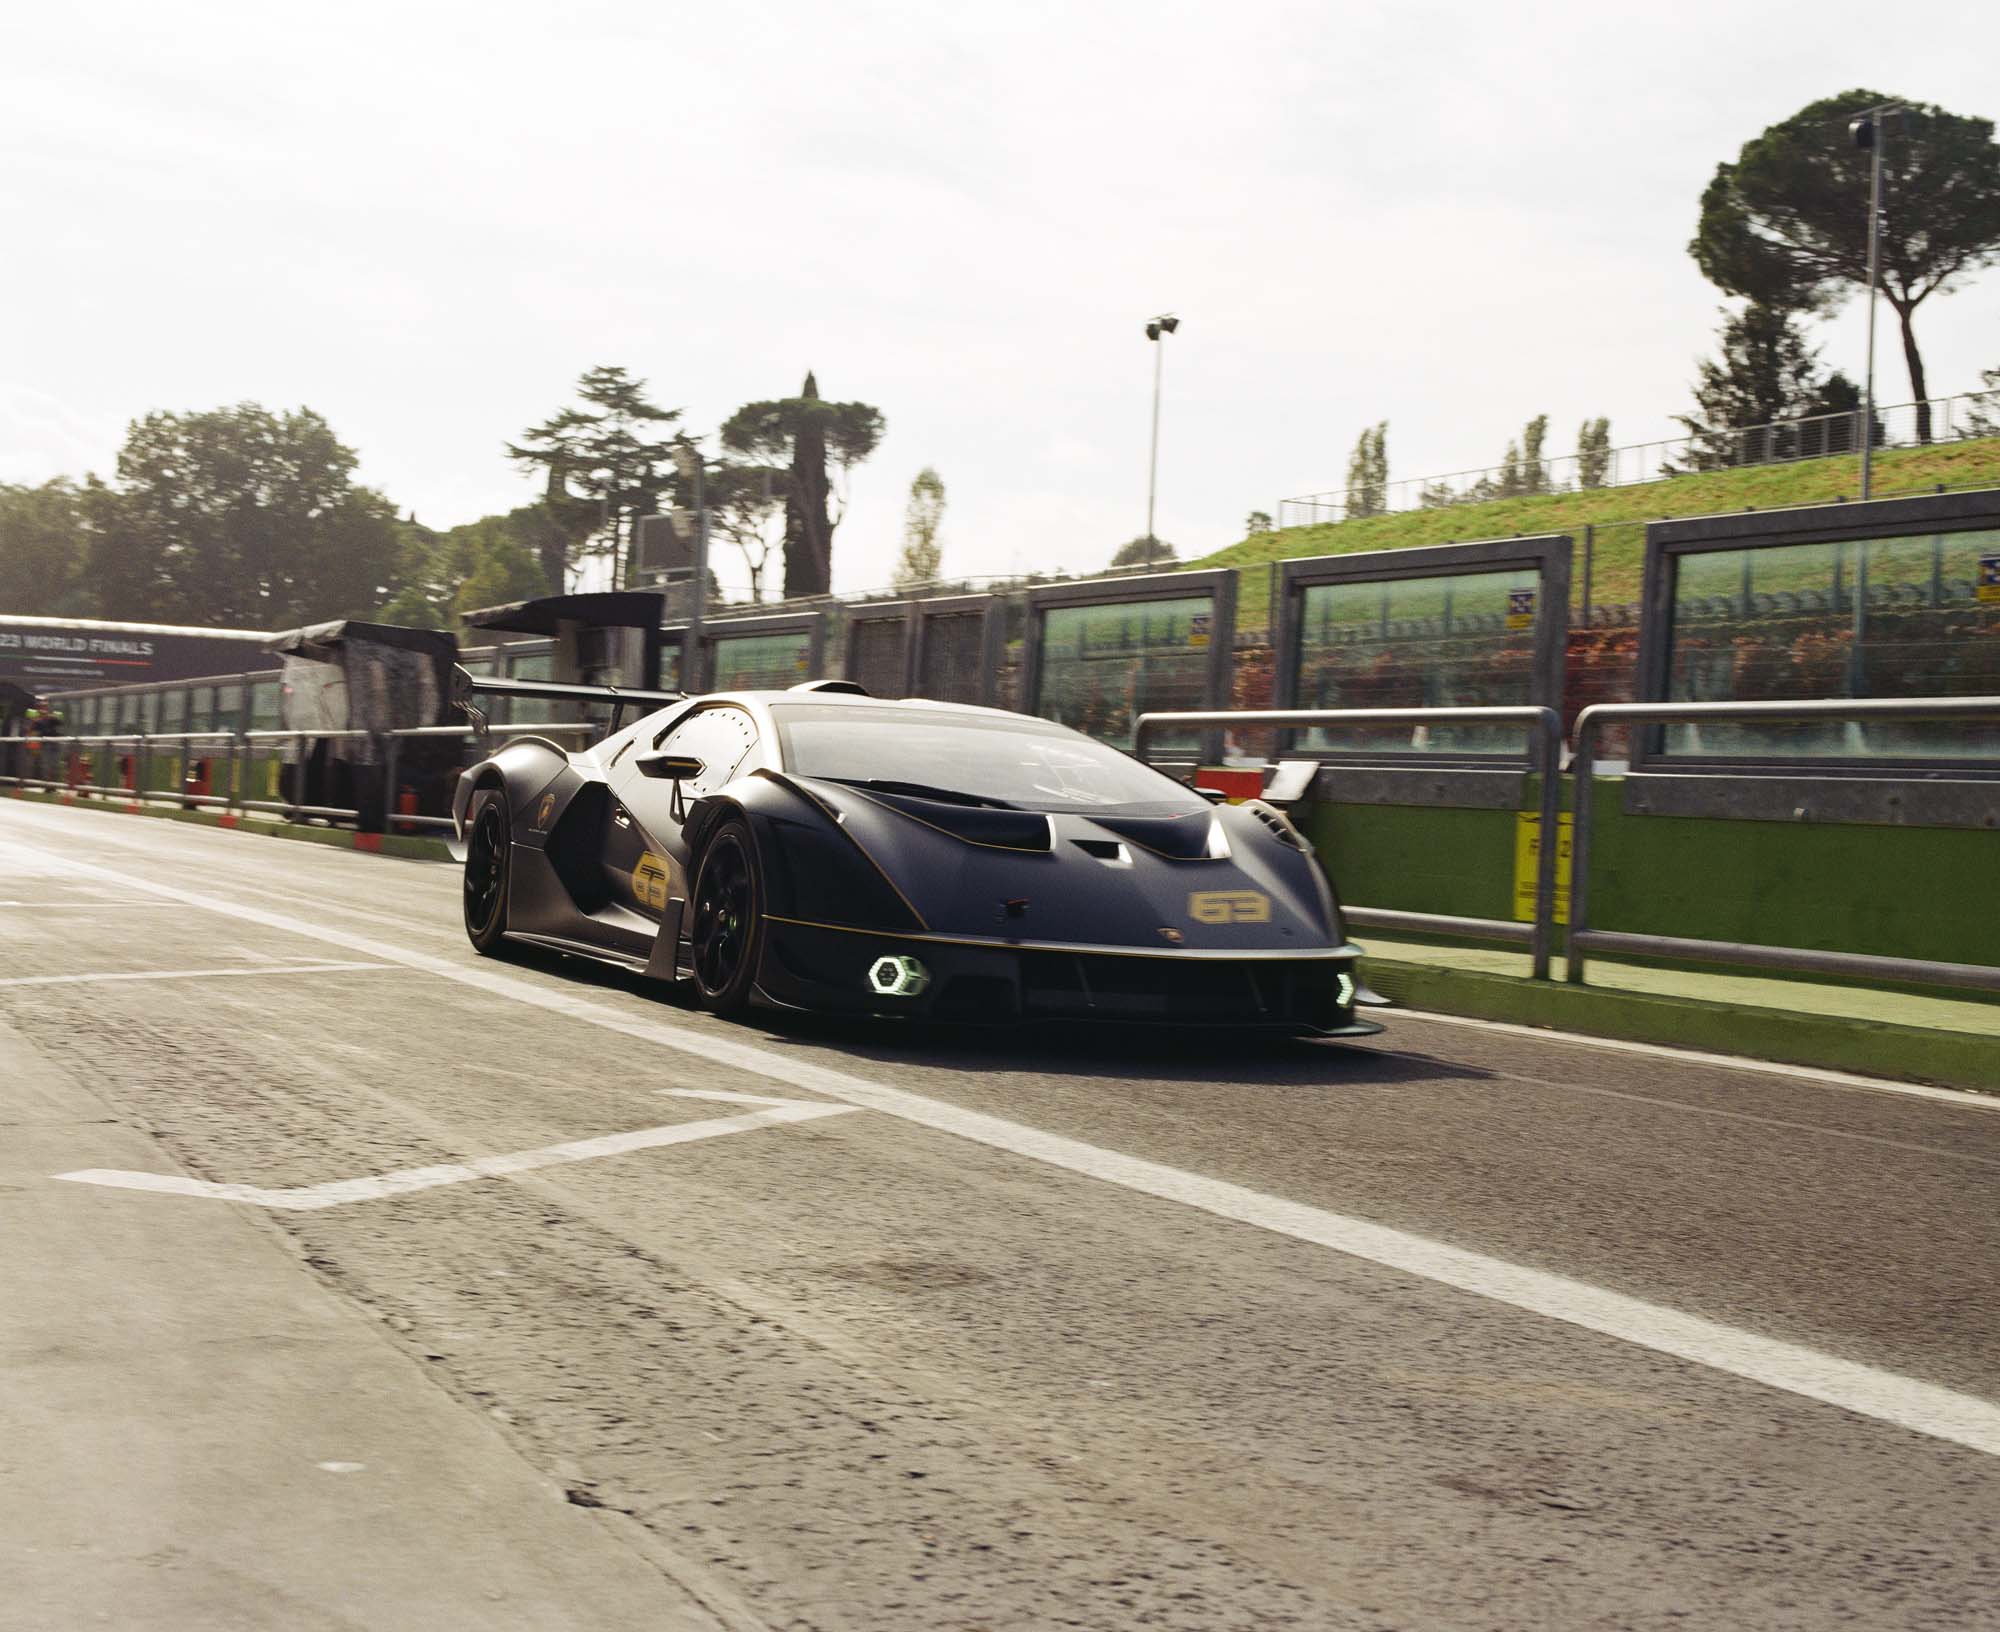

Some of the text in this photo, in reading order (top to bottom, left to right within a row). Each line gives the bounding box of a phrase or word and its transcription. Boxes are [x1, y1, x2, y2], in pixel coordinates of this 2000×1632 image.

[23, 635, 88, 651] WORLD
[89, 639, 154, 655] FINALS
[1188, 889, 1272, 925] 63
